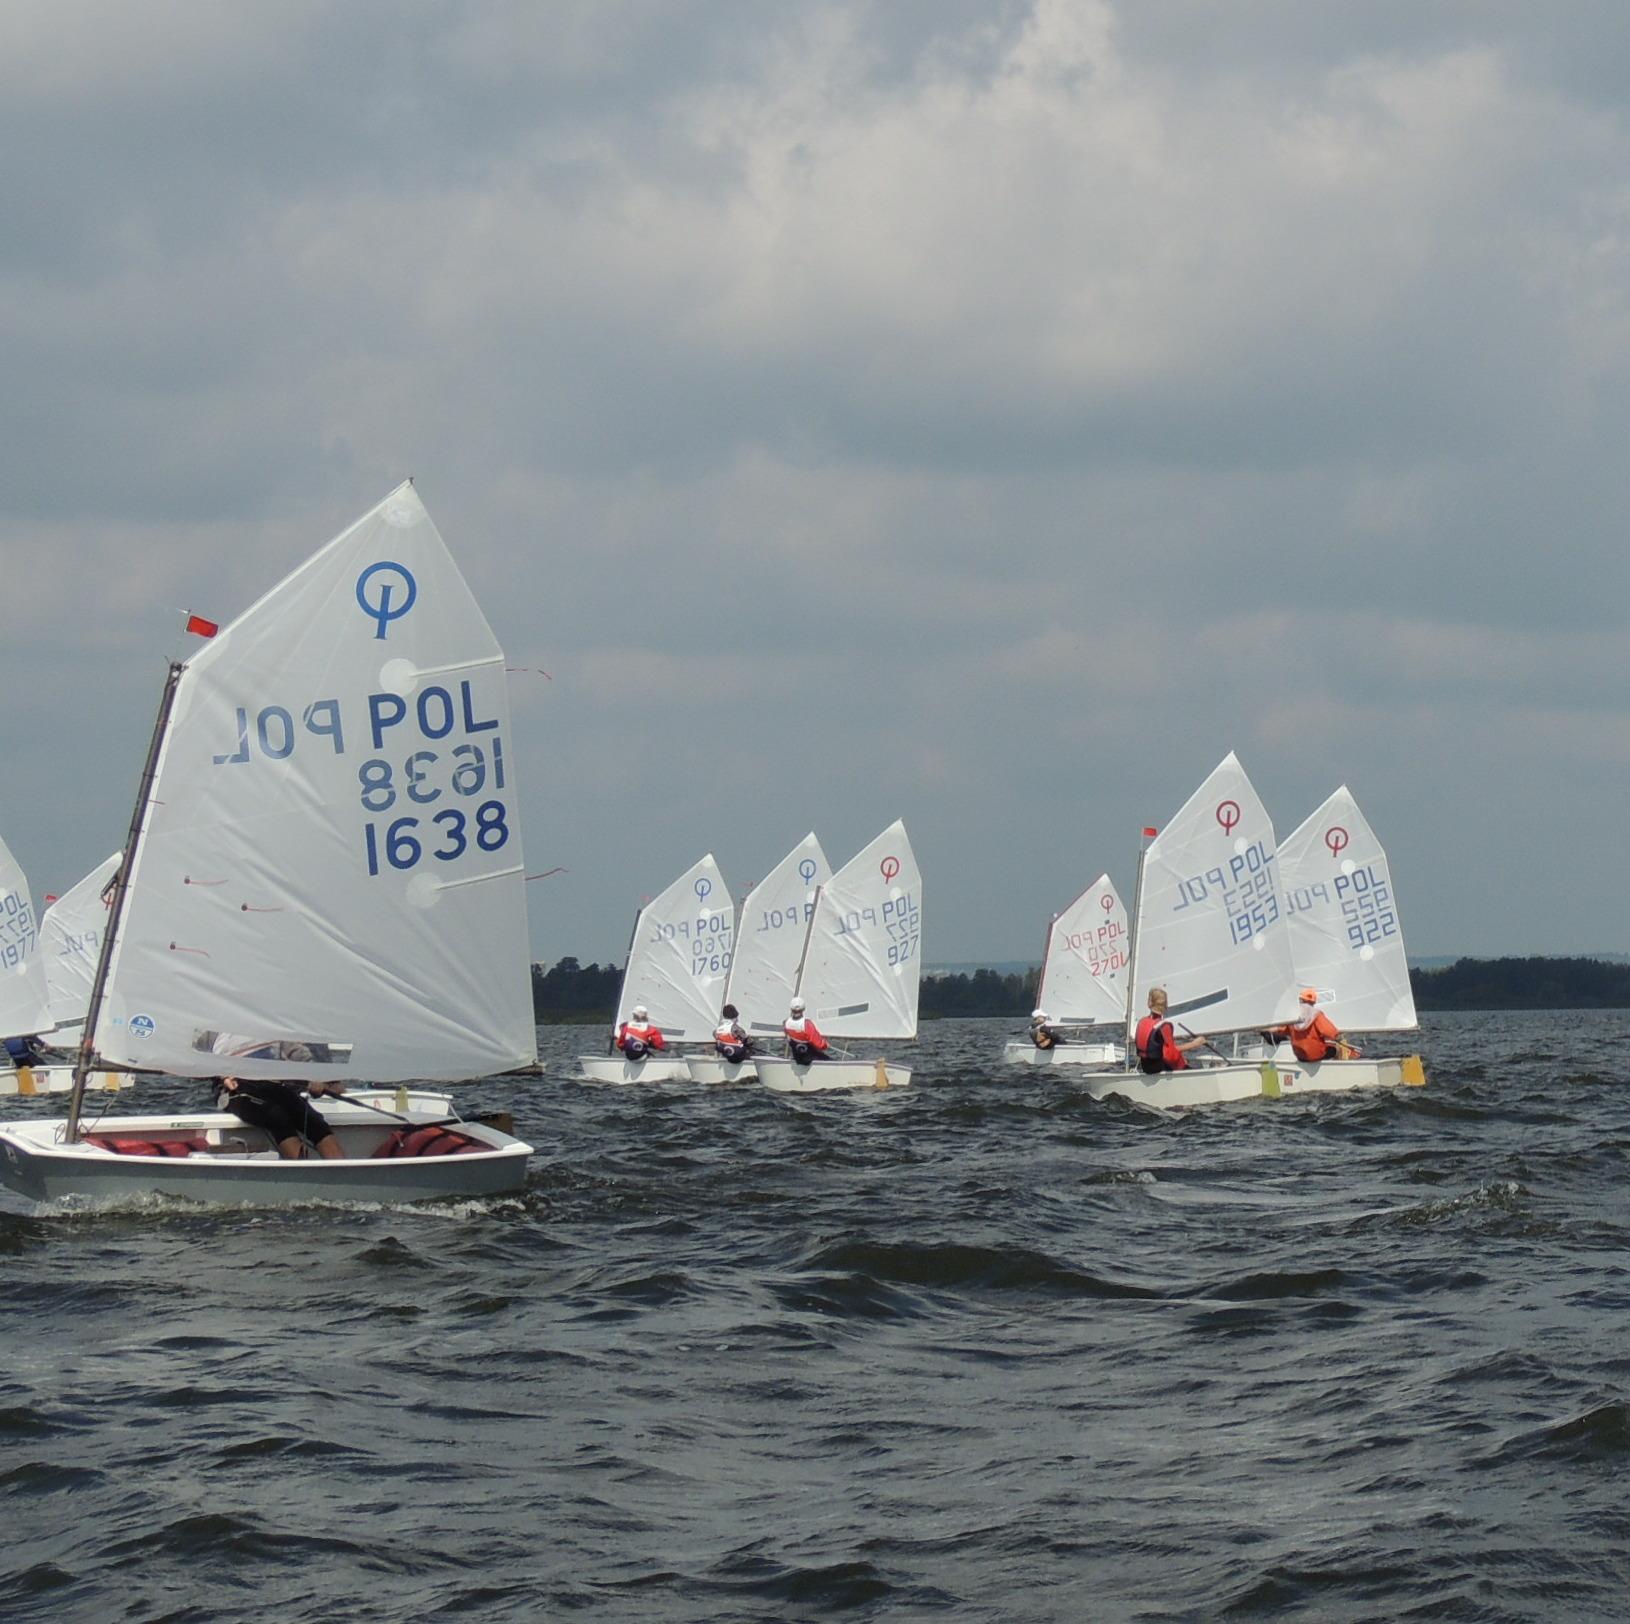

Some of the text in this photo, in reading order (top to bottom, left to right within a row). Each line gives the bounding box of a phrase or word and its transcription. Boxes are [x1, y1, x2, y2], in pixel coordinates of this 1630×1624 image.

[368, 680, 499, 750] POL
[365, 800, 509, 876] 1638
[1229, 840, 1275, 883] POL
[1334, 866, 1386, 899] POL
[696, 914, 731, 936] POL
[882, 893, 918, 922] POL
[1230, 894, 1279, 945] 1953
[1097, 921, 1126, 942] POL
[1348, 912, 1397, 949] 922
[1, 930, 36, 969] 1977
[691, 952, 731, 976] 1760
[888, 934, 919, 967] 927
